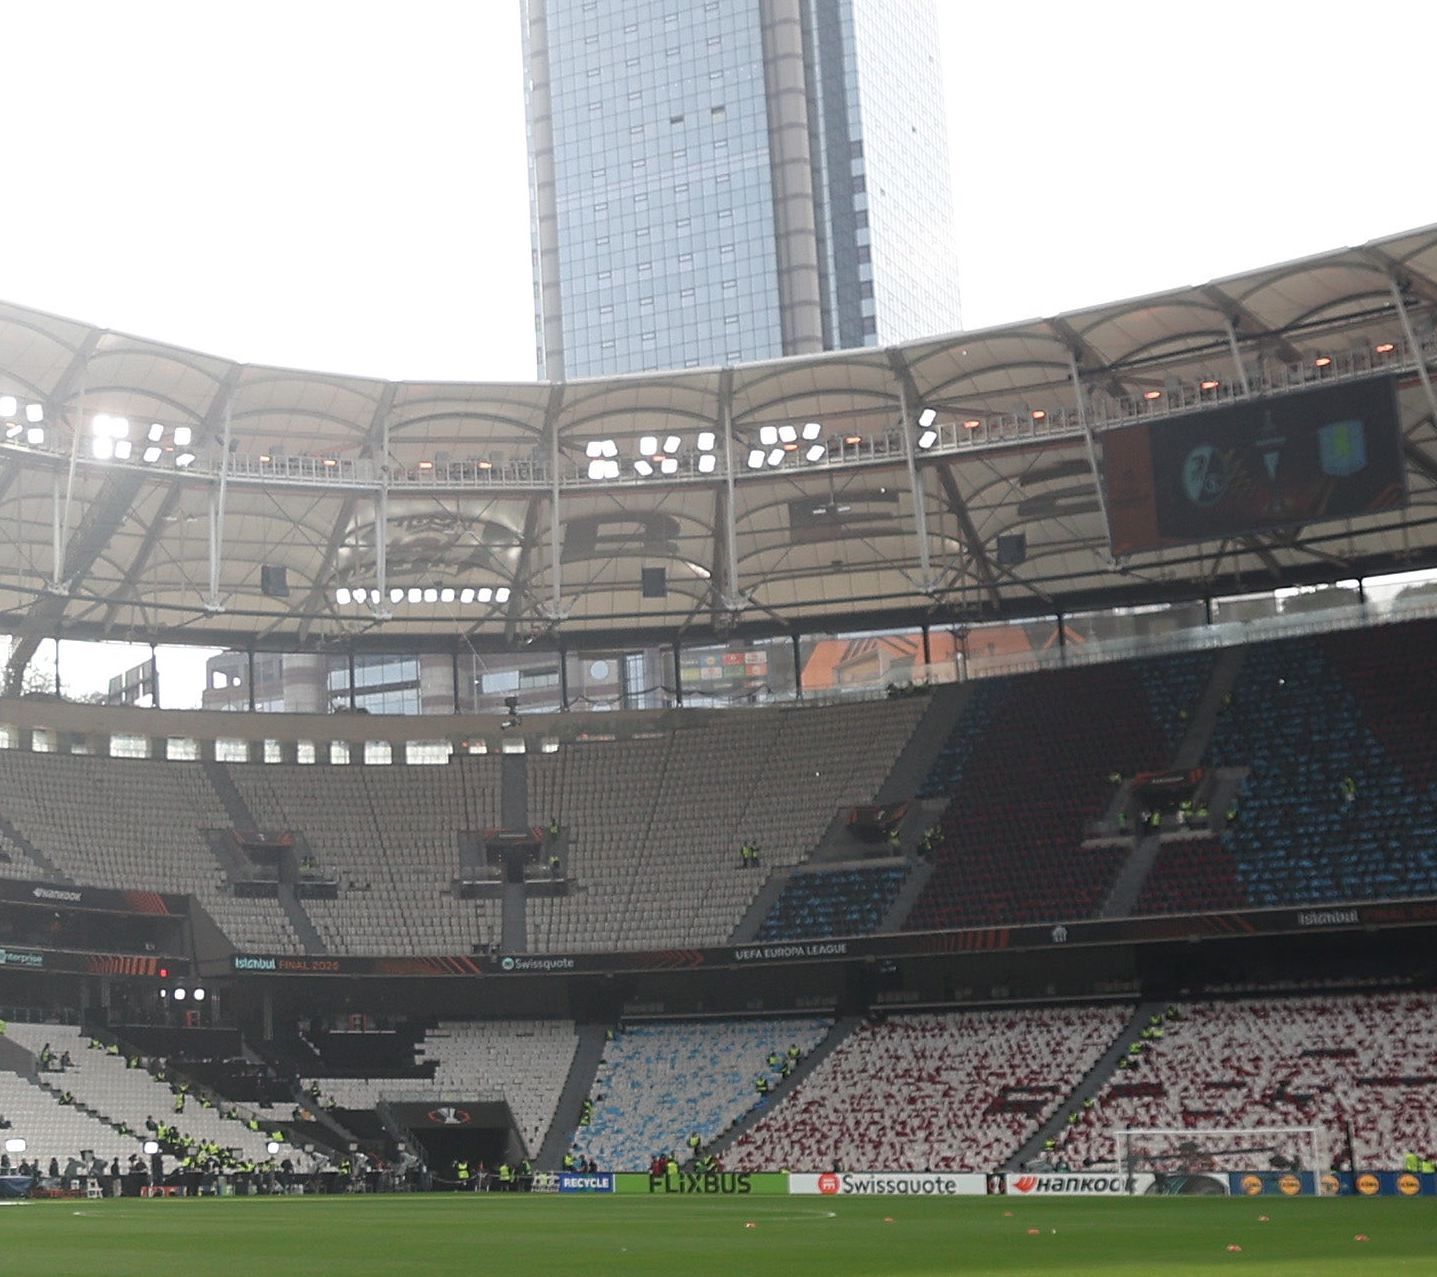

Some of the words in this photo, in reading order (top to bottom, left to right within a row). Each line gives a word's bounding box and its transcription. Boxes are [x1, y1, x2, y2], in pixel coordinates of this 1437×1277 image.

[735, 949, 763, 960] UEFA
[764, 945, 805, 958] EUROPA
[807, 943, 847, 956] LEAGUE
[235, 957, 276, 971] Istanbul
[279, 960, 310, 971] FINAL
[515, 957, 574, 971] Swissquote
[564, 1177, 610, 1189] RECYCLE
[842, 1175, 957, 1195] Swissquote
